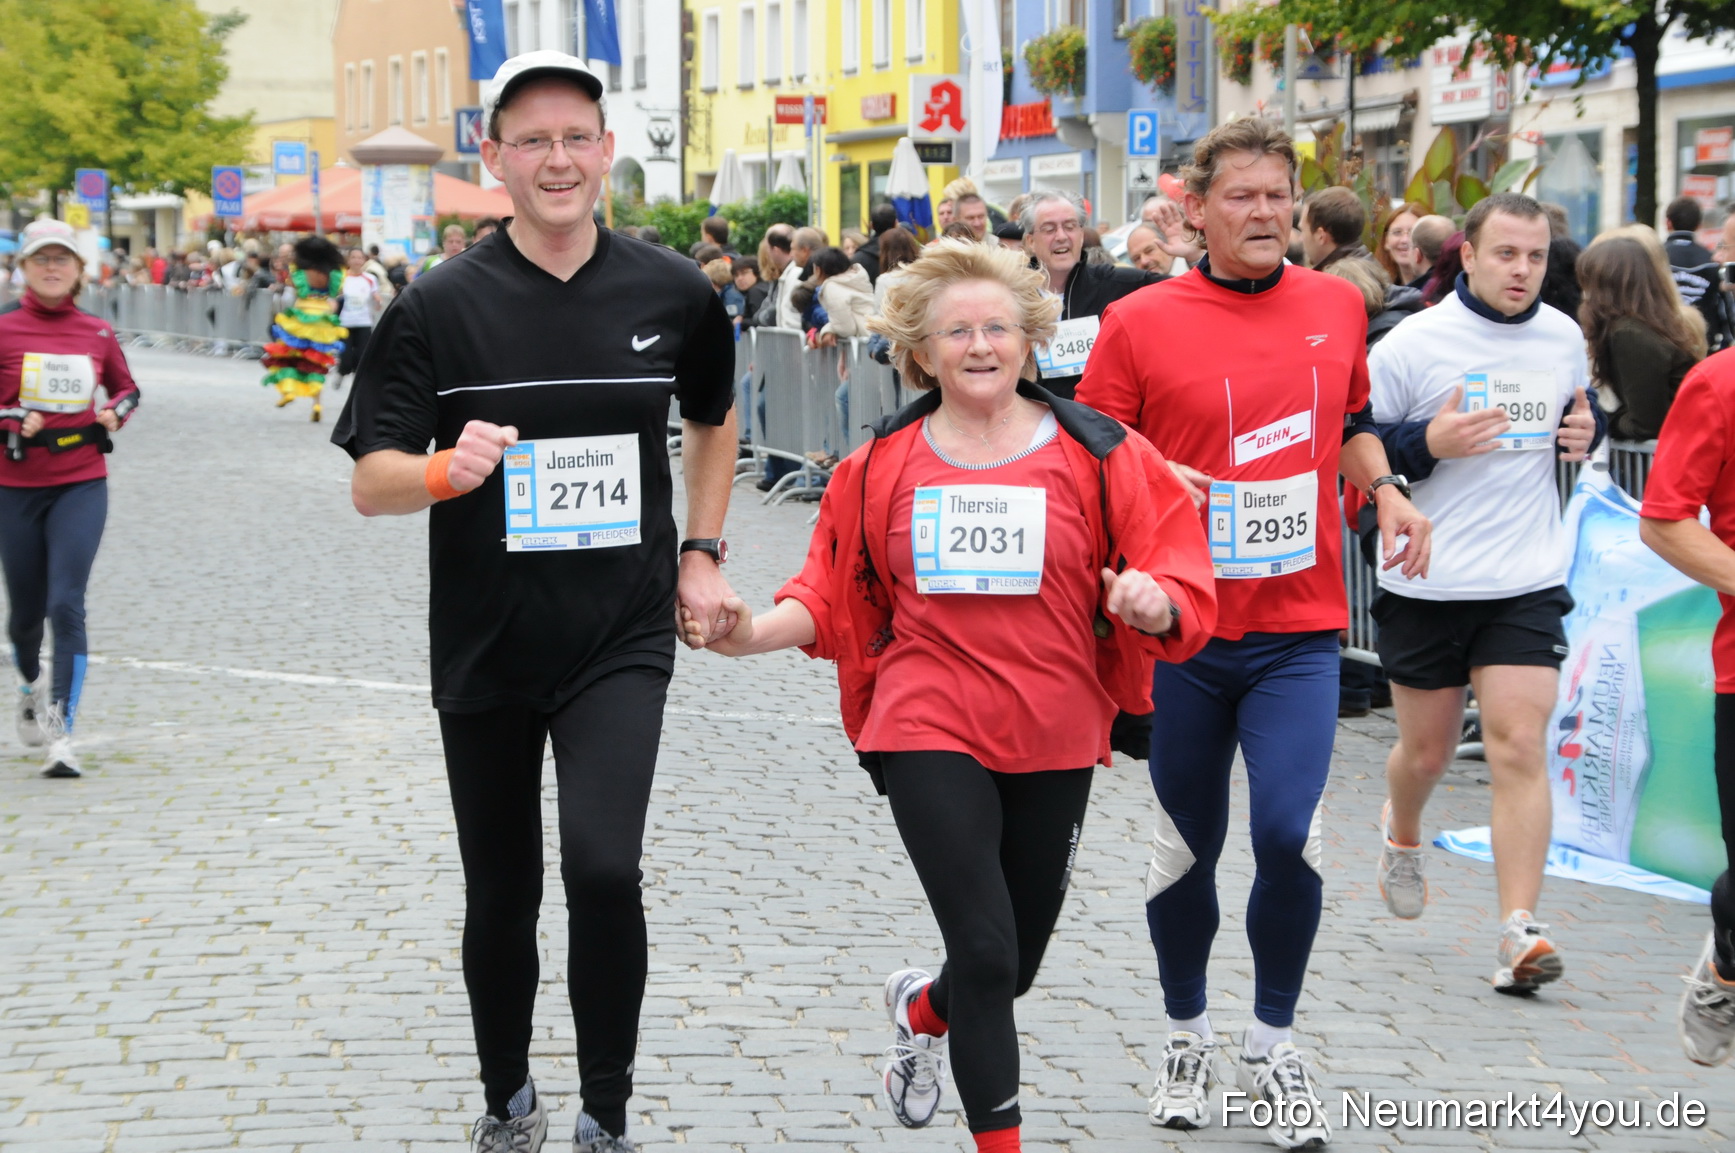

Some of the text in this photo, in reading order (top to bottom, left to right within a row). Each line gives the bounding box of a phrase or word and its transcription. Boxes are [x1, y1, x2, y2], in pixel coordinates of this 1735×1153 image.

[1134, 115, 1152, 152] P
[217, 200, 240, 213] TAXI
[1056, 338, 1094, 357] 3486
[43, 361, 69, 372] Maria
[48, 378, 82, 394] 936
[1494, 379, 1521, 393] Hans
[1257, 426, 1290, 449] DEHN
[547, 449, 614, 470] Joachim
[517, 482, 525, 497] D
[550, 478, 628, 510] 2714
[950, 495, 1008, 514] Thersia
[1244, 492, 1287, 508] Dieter
[1217, 518, 1224, 531] C
[1246, 511, 1307, 544] 2935
[592, 528, 638, 540] PFLEIDERER
[949, 526, 1024, 554] 2031
[1283, 552, 1315, 568] PFLEIDERER
[990, 578, 1039, 587] PFLEIDERER
